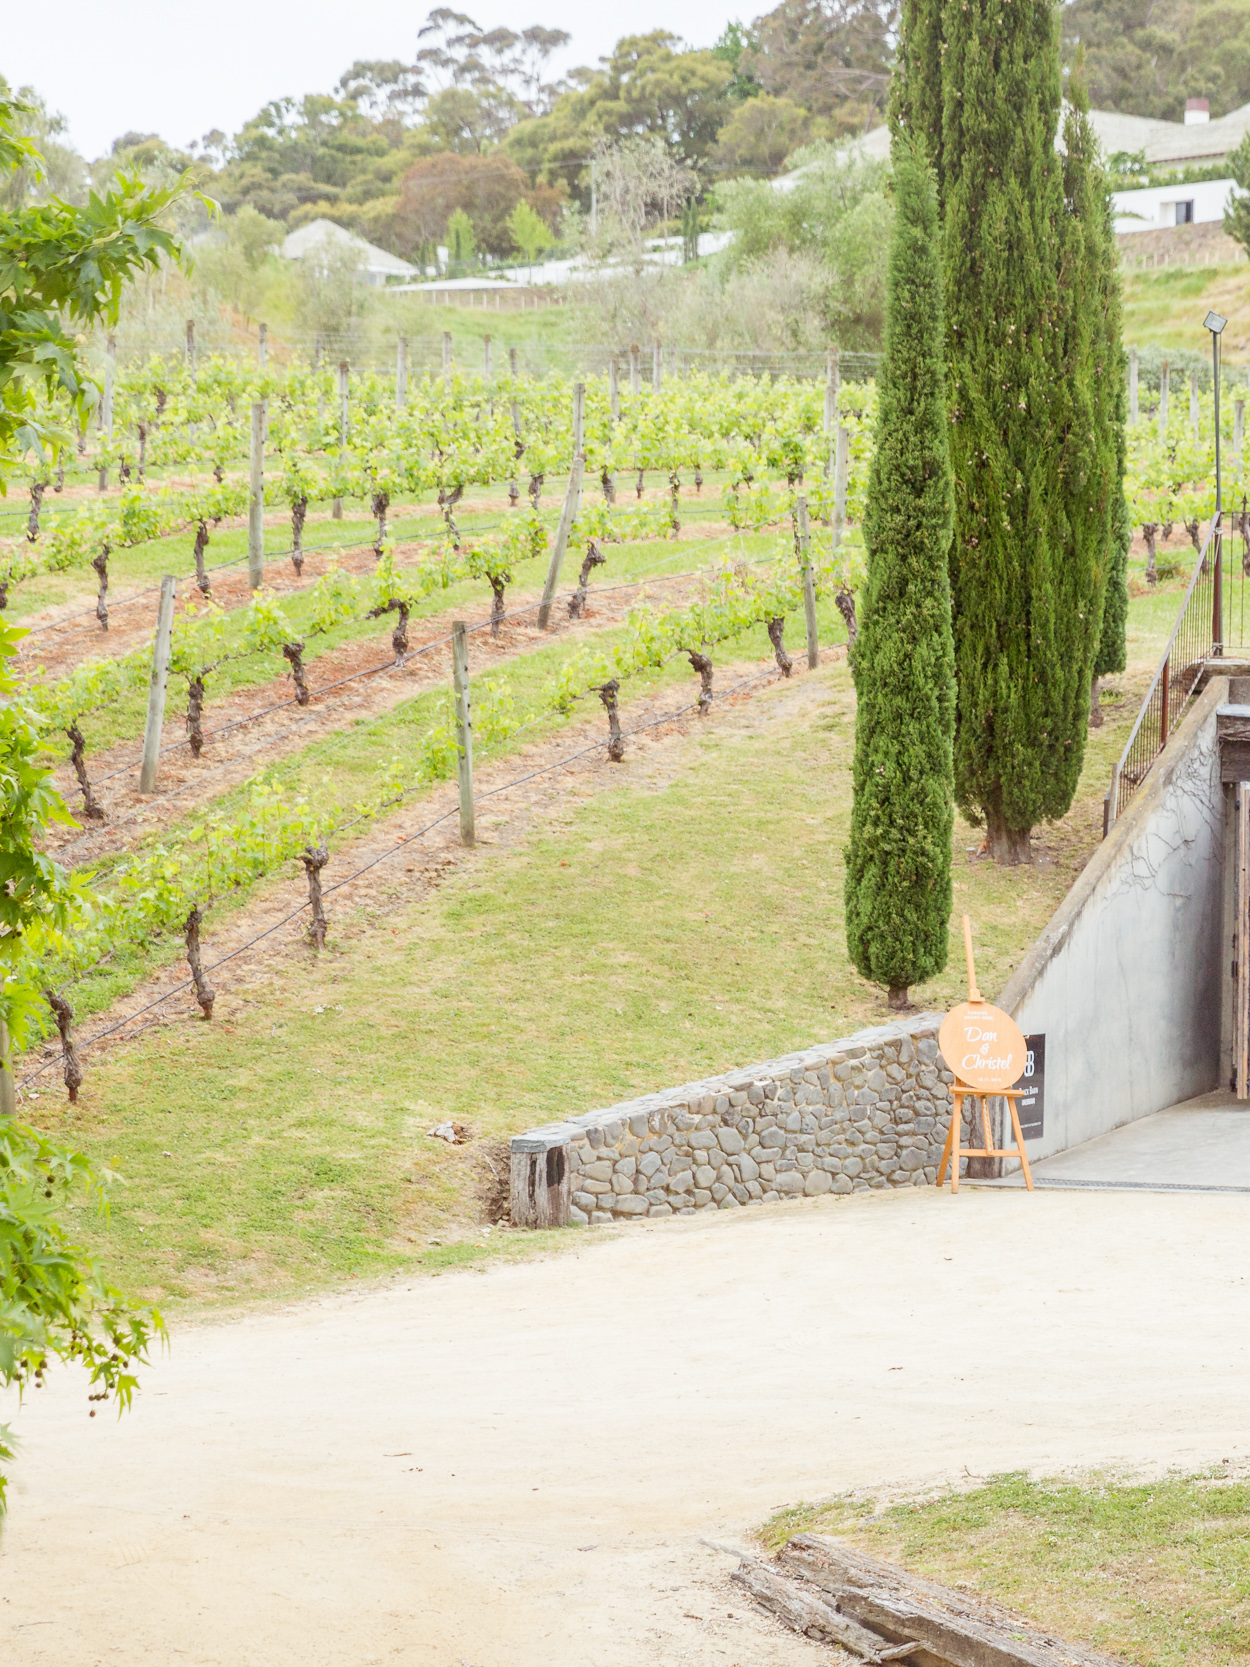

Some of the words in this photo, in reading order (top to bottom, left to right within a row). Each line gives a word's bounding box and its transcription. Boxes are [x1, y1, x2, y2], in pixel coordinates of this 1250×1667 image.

[963, 1026, 998, 1042] Dan
[979, 1042, 990, 1056] &
[962, 1053, 1013, 1070] Christel
